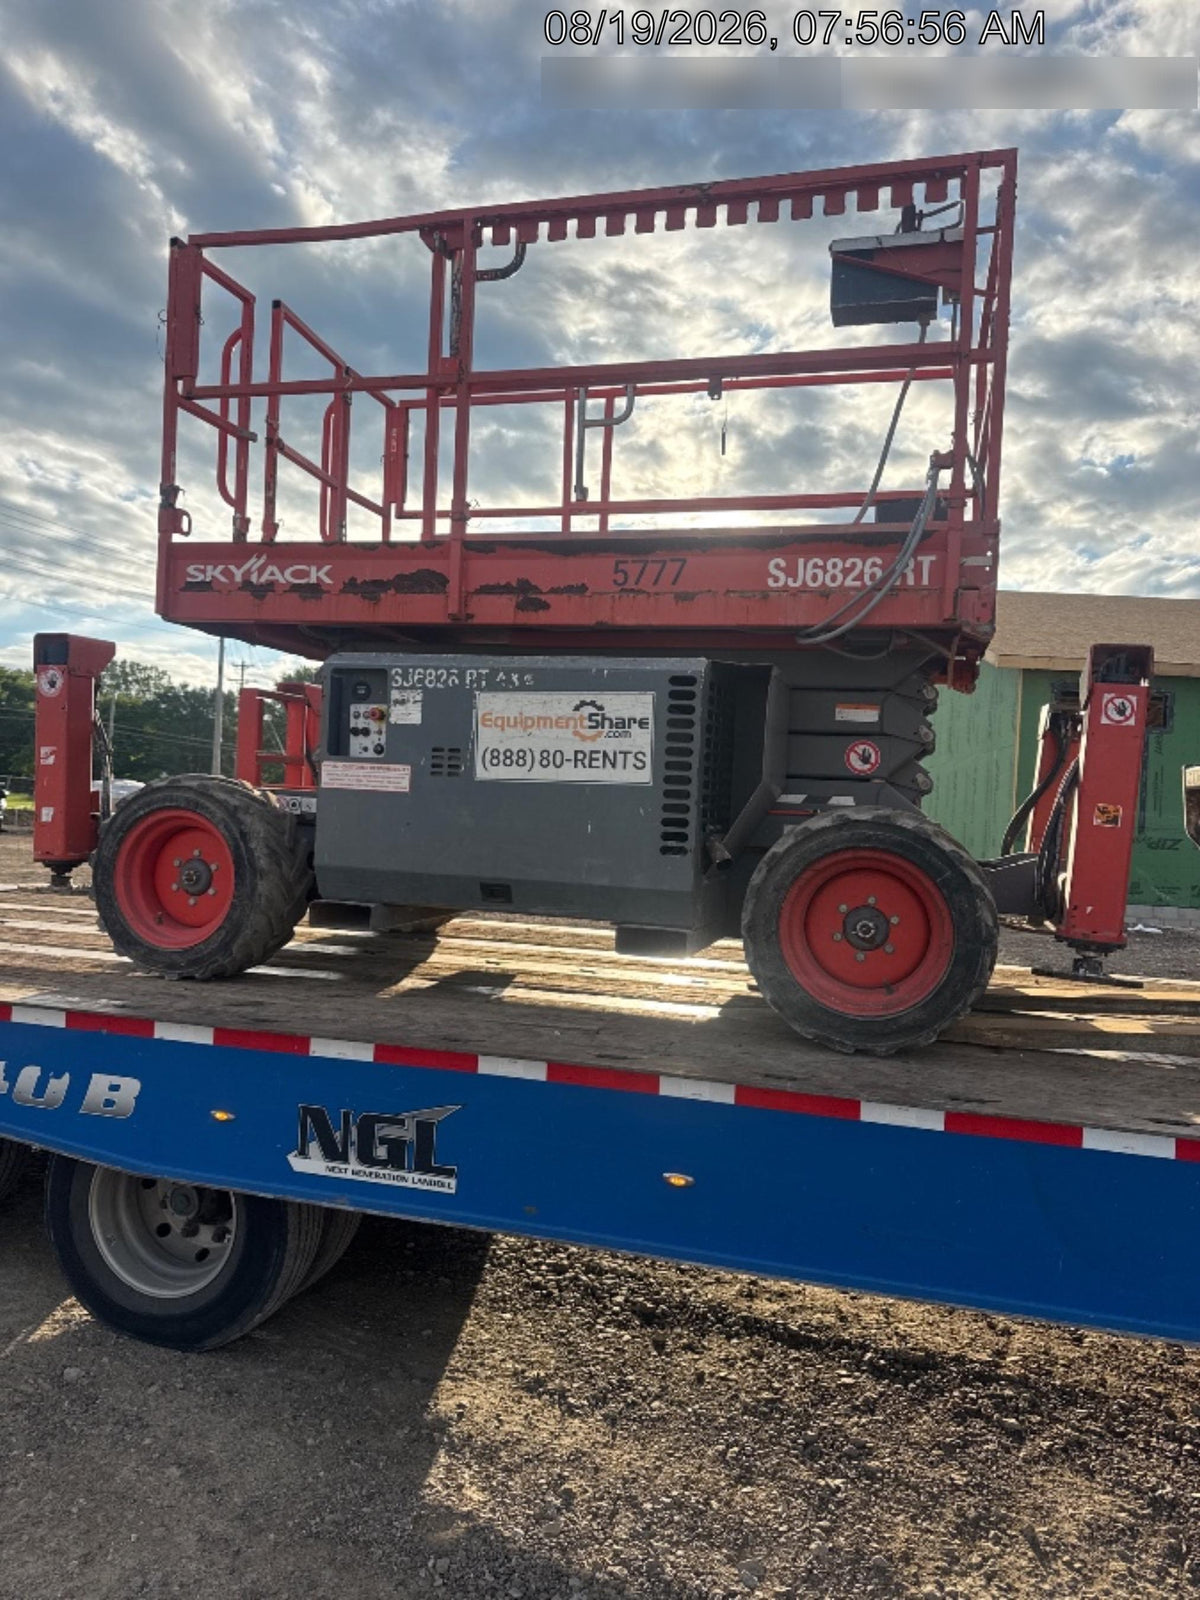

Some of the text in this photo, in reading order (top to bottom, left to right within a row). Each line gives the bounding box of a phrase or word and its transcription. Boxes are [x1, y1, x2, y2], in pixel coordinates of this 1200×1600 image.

[186, 553, 334, 584] SKYJACK
[613, 558, 687, 587] 5777
[767, 556, 883, 588] SJ6826
[480, 711, 650, 732] EquipmentShare
[604, 731, 632, 739] .com
[482, 747, 647, 773] (888) 80-RENTS
[298, 1103, 457, 1178] NGL
[325, 1165, 348, 1175] NEXT
